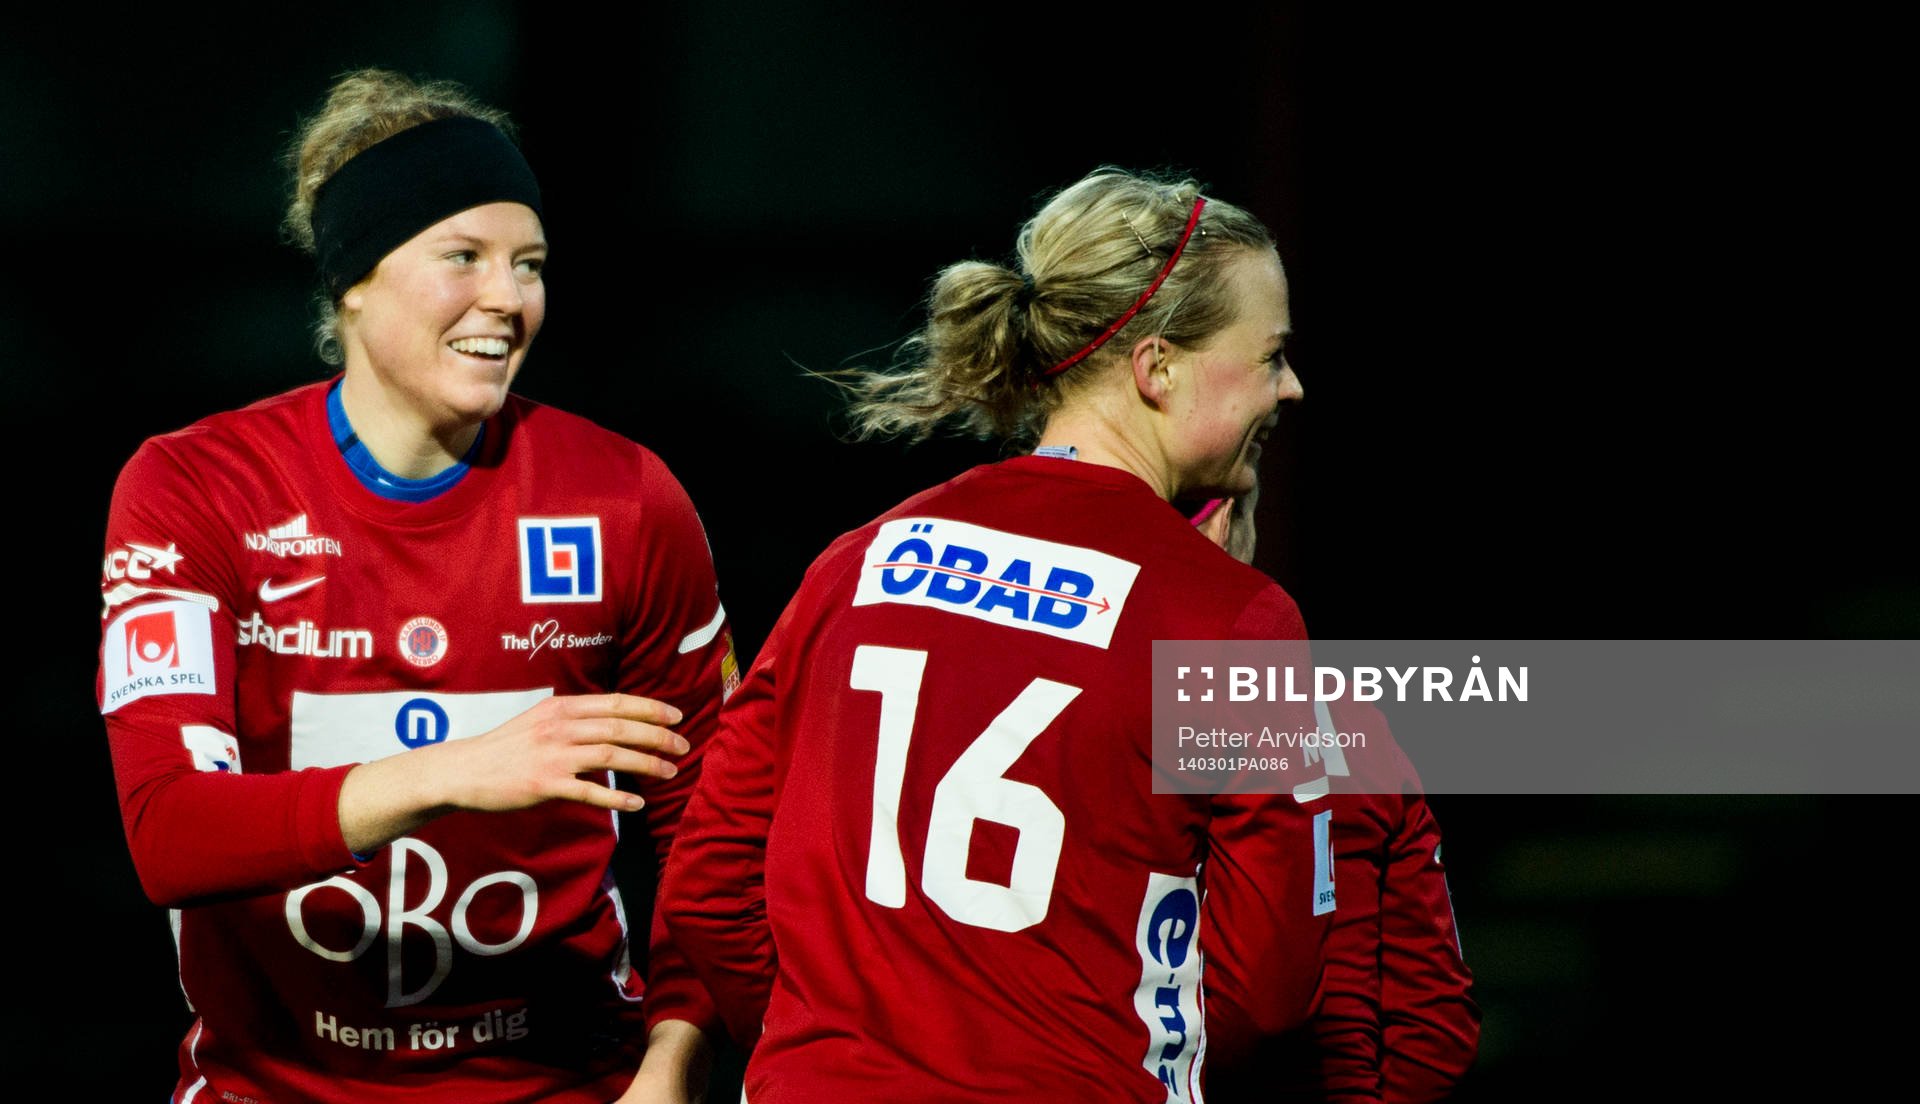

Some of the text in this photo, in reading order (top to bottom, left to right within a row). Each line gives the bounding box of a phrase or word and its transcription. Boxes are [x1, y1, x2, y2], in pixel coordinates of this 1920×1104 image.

[880, 523, 1095, 630] ÖBAB
[238, 612, 373, 658] stadium
[502, 632, 613, 650] The of Sweden
[111, 673, 205, 703] SVENSKA SPEL
[849, 644, 1084, 934] 16
[315, 1008, 529, 1051] Hem för dig
